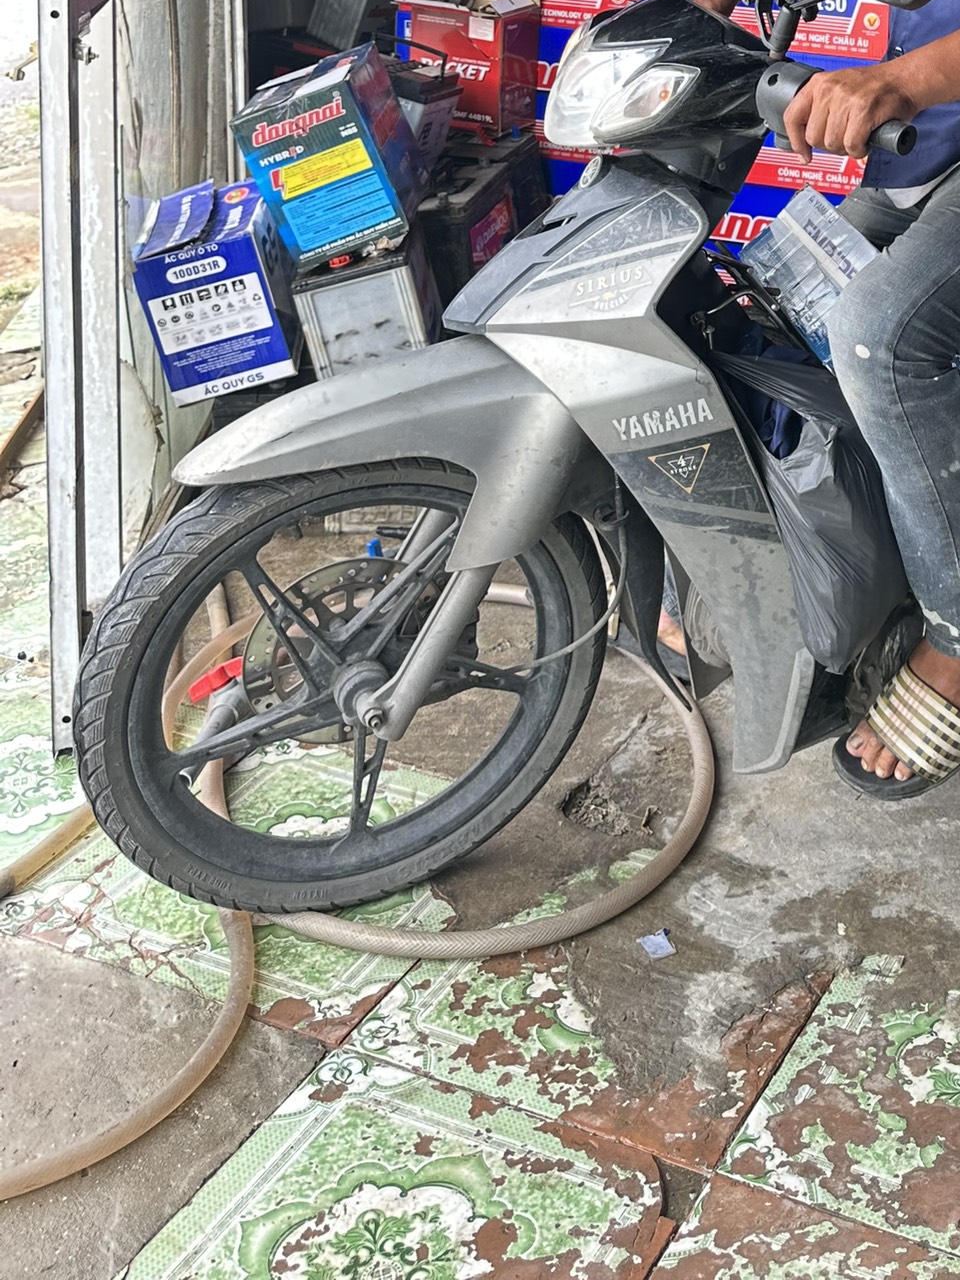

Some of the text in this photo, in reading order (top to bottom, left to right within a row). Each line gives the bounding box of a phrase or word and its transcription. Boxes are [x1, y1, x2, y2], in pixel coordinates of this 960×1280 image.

[809, 33, 869, 48] NGHỆ CHÂU ÂU
[777, 166, 800, 178] CÔNG
[802, 170, 823, 181] NGHỆ
[826, 173, 848, 184] CHÂU
[178, 250, 196, 260] QUY
[173, 260, 220, 279] 100D31R
[575, 265, 644, 297] SIRIUS
[594, 293, 629, 311] SPECIAL
[222, 372, 265, 391] QUY GS
[612, 398, 714, 441] YAMAHA
[670, 465, 697, 475] STROKE
[677, 455, 687, 467] 4
